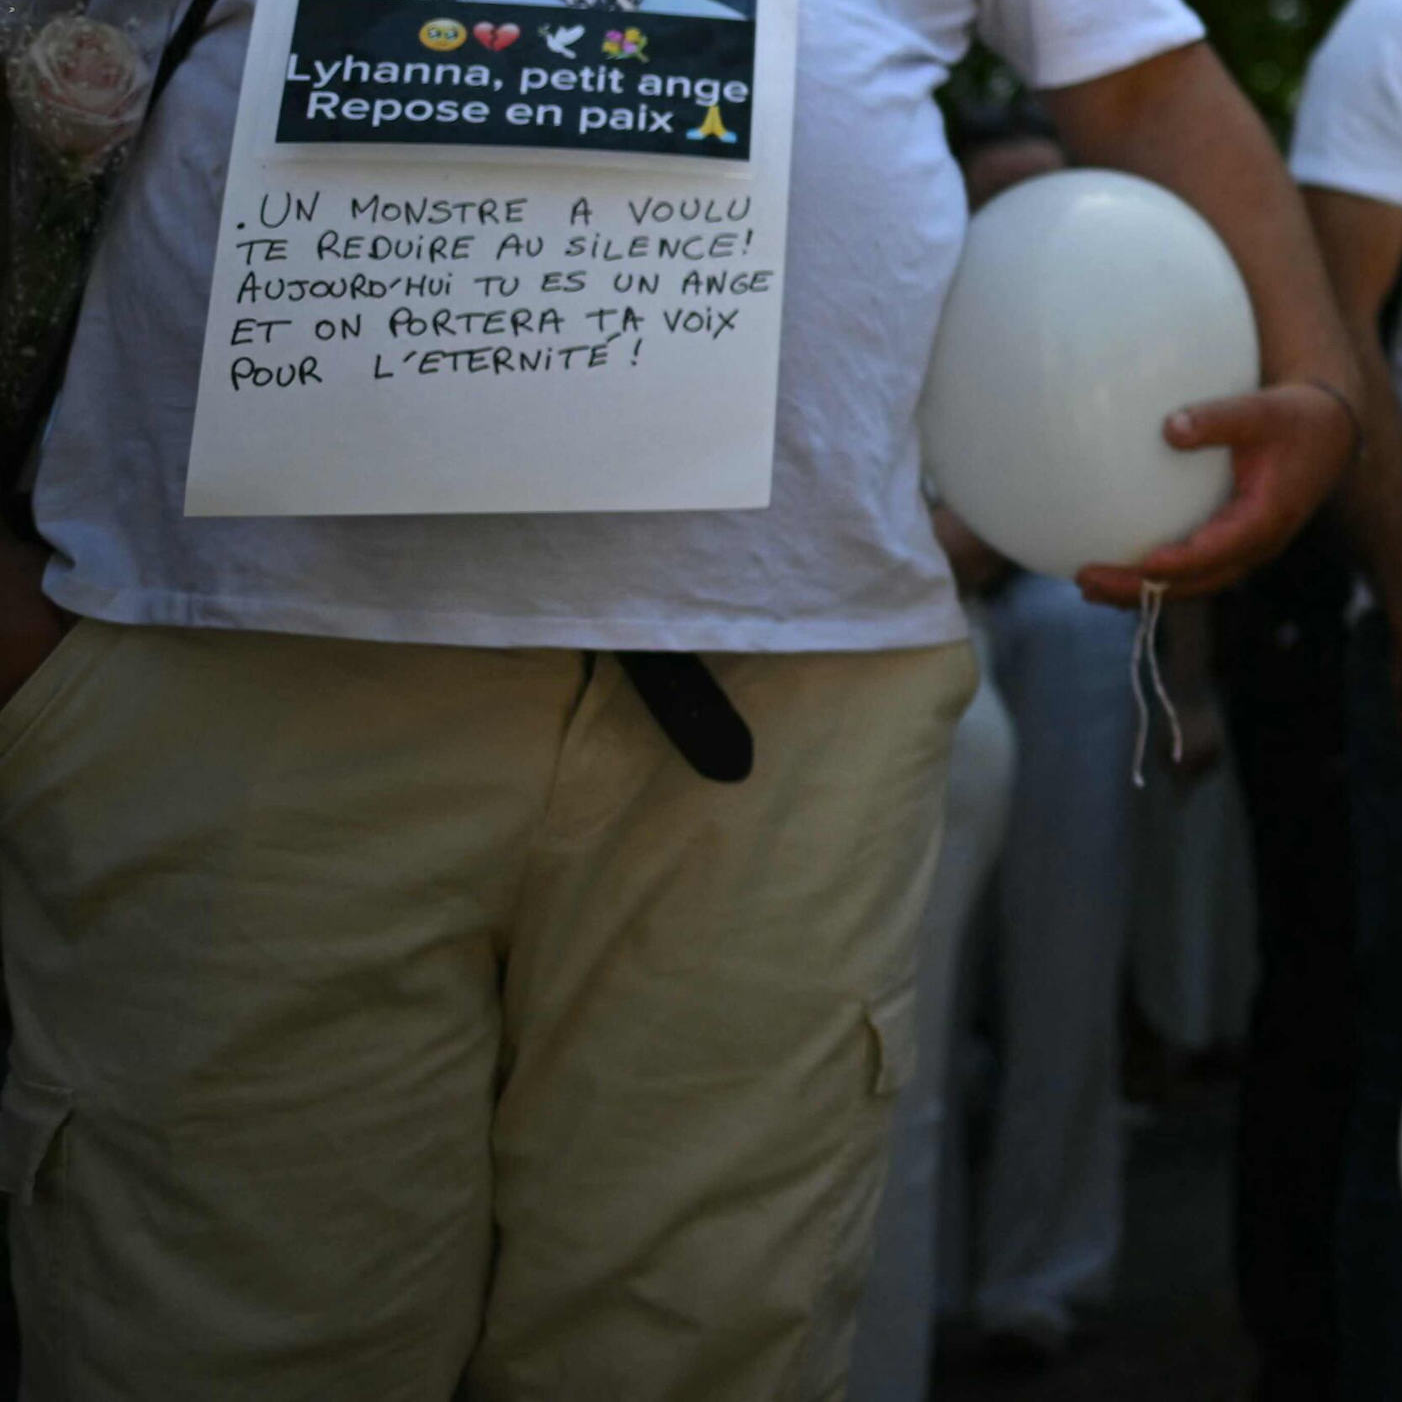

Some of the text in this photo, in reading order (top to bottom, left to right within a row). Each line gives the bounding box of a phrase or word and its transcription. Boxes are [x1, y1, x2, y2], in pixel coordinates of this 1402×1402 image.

[286, 53, 748, 106] Lyhanna, petit ange
[306, 92, 674, 134] Repose en paix
[351, 194, 528, 226] MONSTRE
[570, 196, 593, 225] A
[629, 196, 752, 225] VOULU
[236, 239, 288, 265] TE
[496, 233, 544, 260] AU
[474, 276, 520, 297] TU
[541, 270, 587, 293] ES
[613, 273, 660, 295] UN
[681, 269, 774, 295] ANGE
[230, 318, 292, 346] ET
[314, 314, 362, 341] ON
[389, 307, 565, 338] PORTERA
[585, 306, 645, 332] TA
[231, 356, 323, 391] POUR
